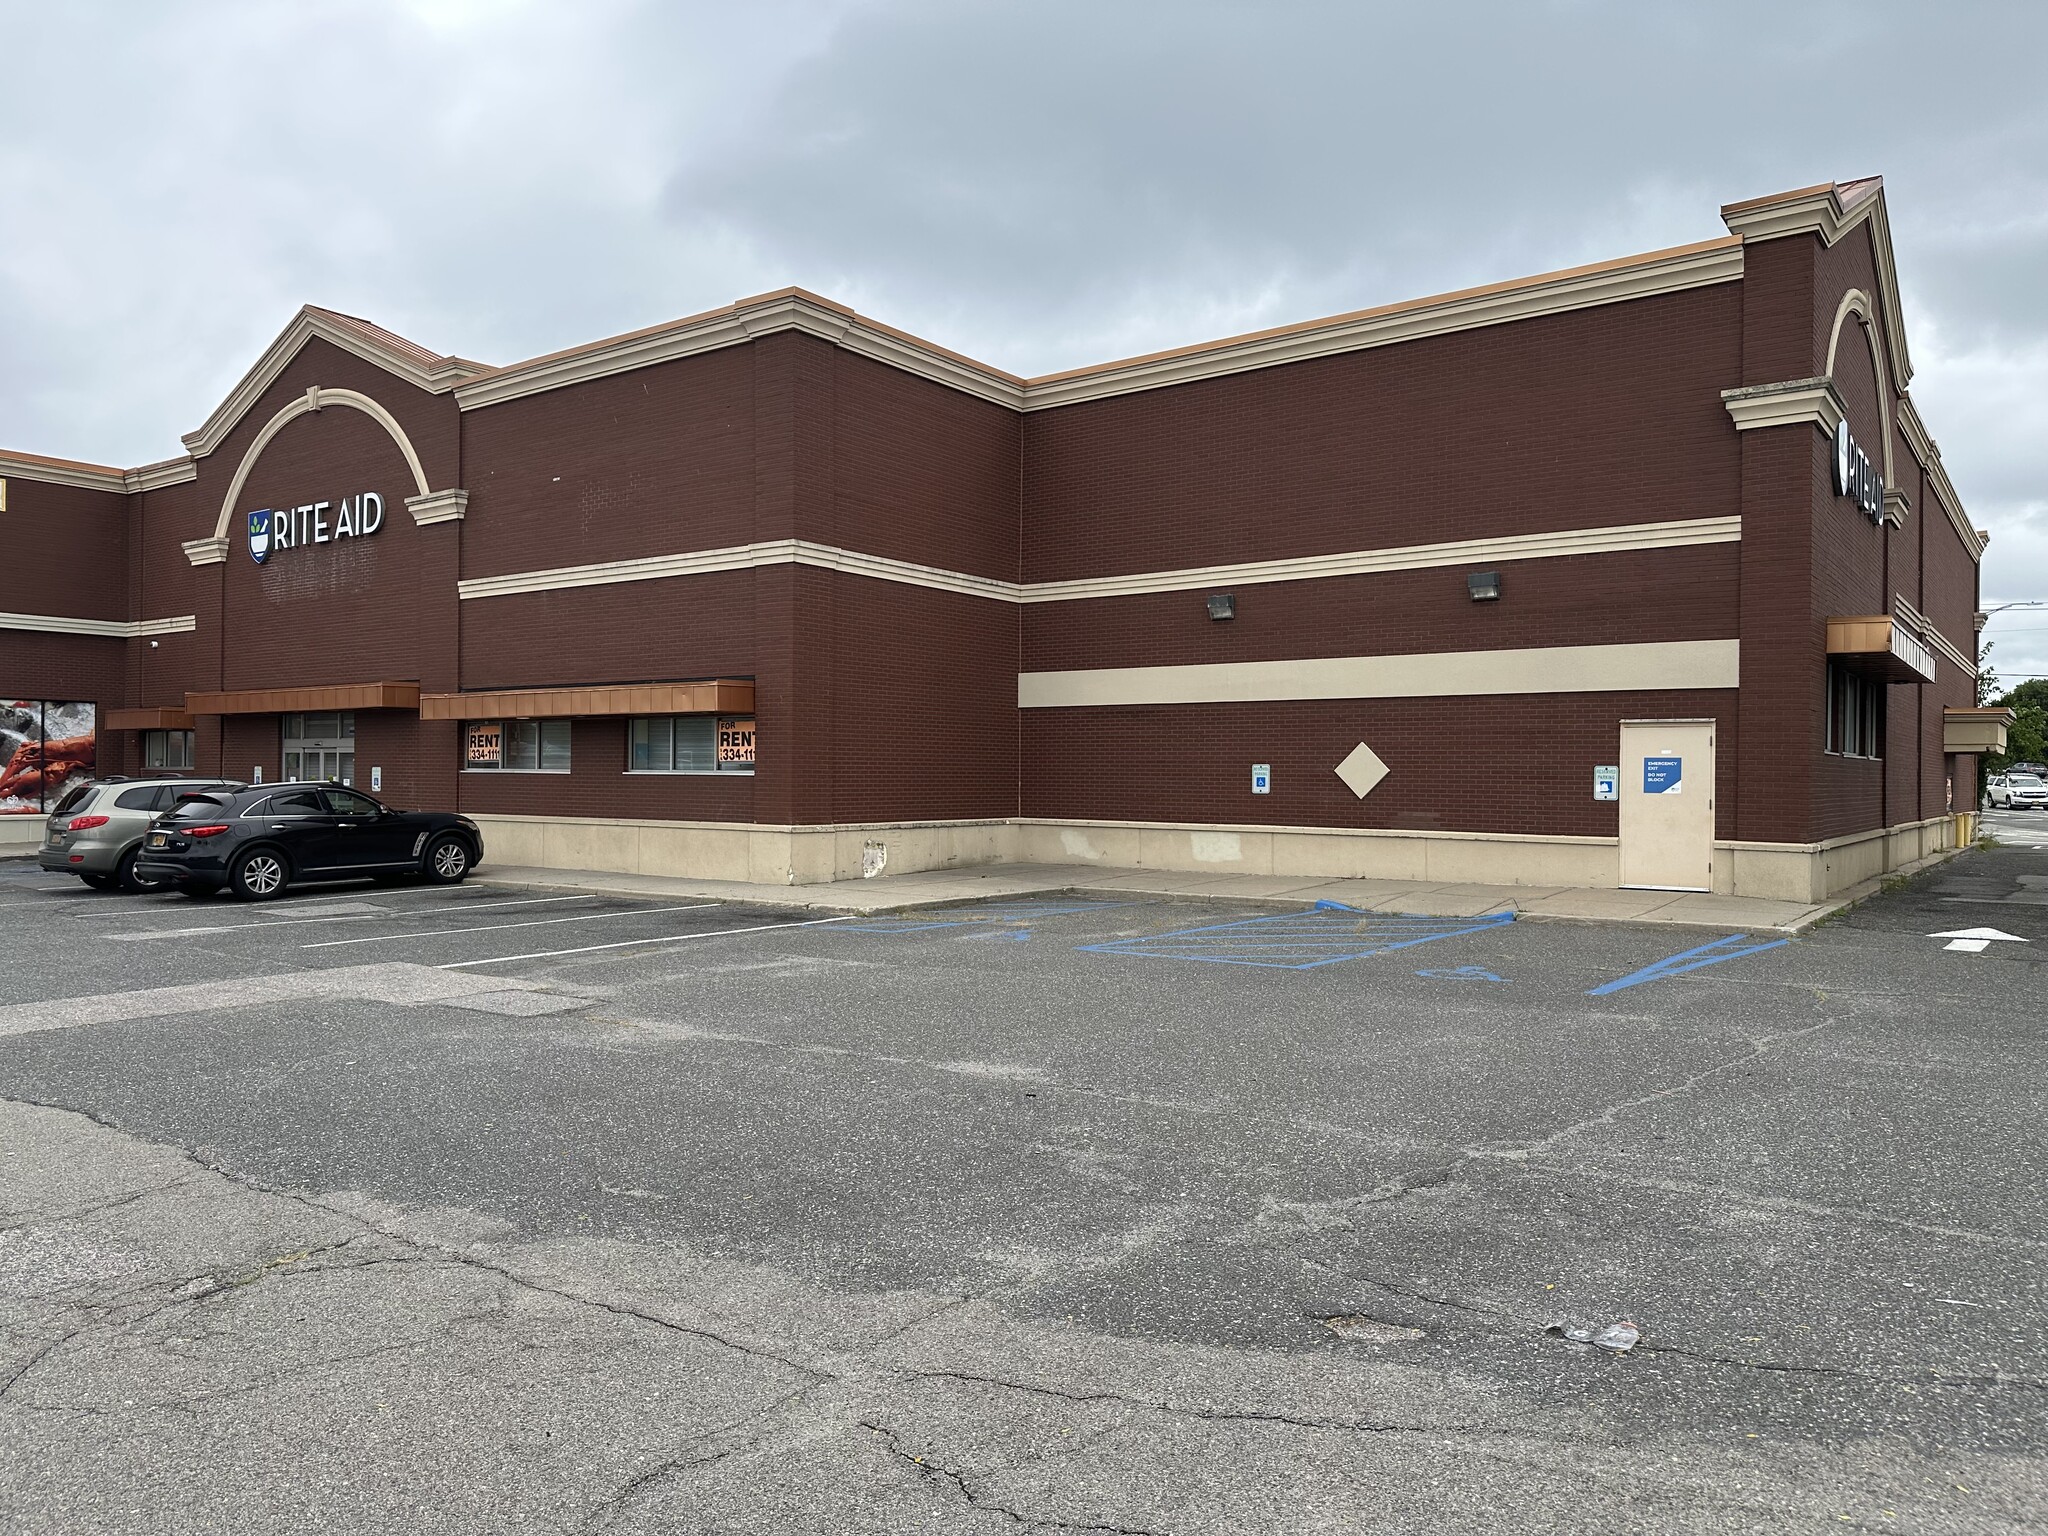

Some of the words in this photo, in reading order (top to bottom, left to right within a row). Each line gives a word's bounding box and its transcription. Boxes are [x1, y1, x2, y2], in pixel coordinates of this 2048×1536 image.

[274, 501, 329, 550] RITE
[334, 492, 382, 539] AID
[720, 721, 736, 730] FOR
[470, 734, 500, 748] RENT
